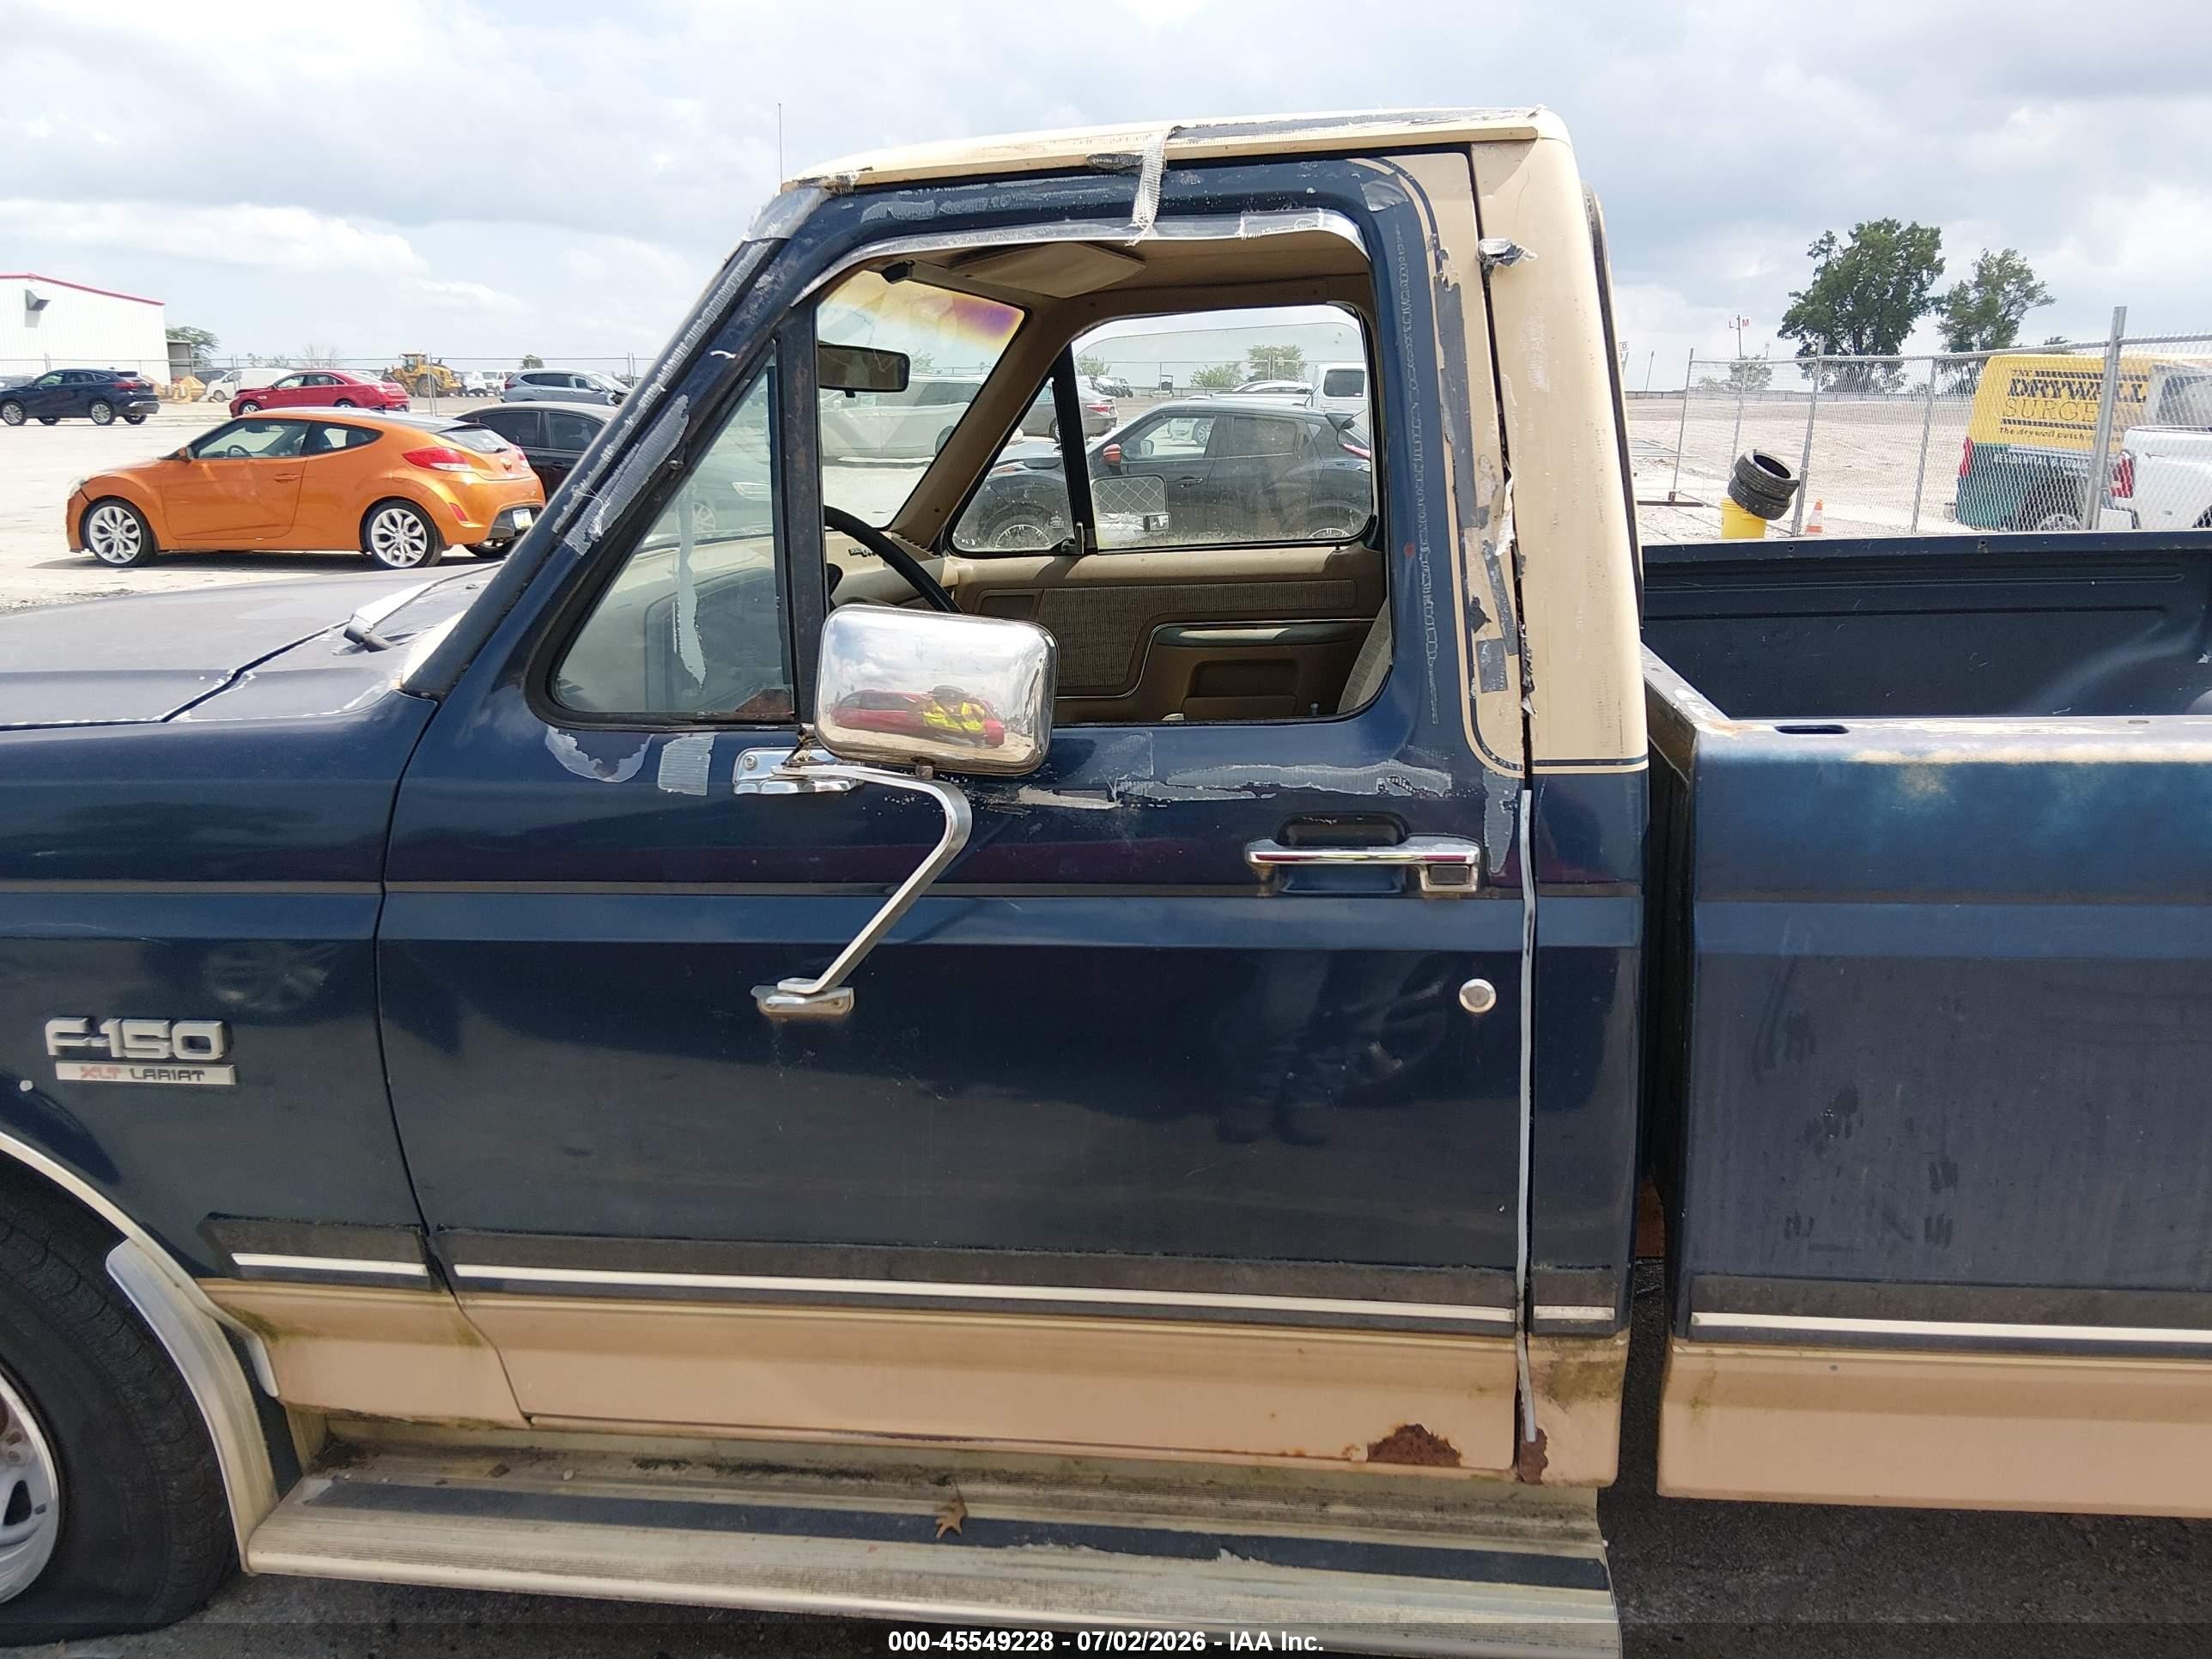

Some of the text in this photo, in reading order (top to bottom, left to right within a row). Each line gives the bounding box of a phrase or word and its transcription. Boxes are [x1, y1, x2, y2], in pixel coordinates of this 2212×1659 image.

[2017, 428, 2055, 438] drywall
[1994, 453, 2048, 465] RESIDENTIAL
[46, 1017, 225, 1060] F-150
[80, 1066, 205, 1081] XLT LARIAT
